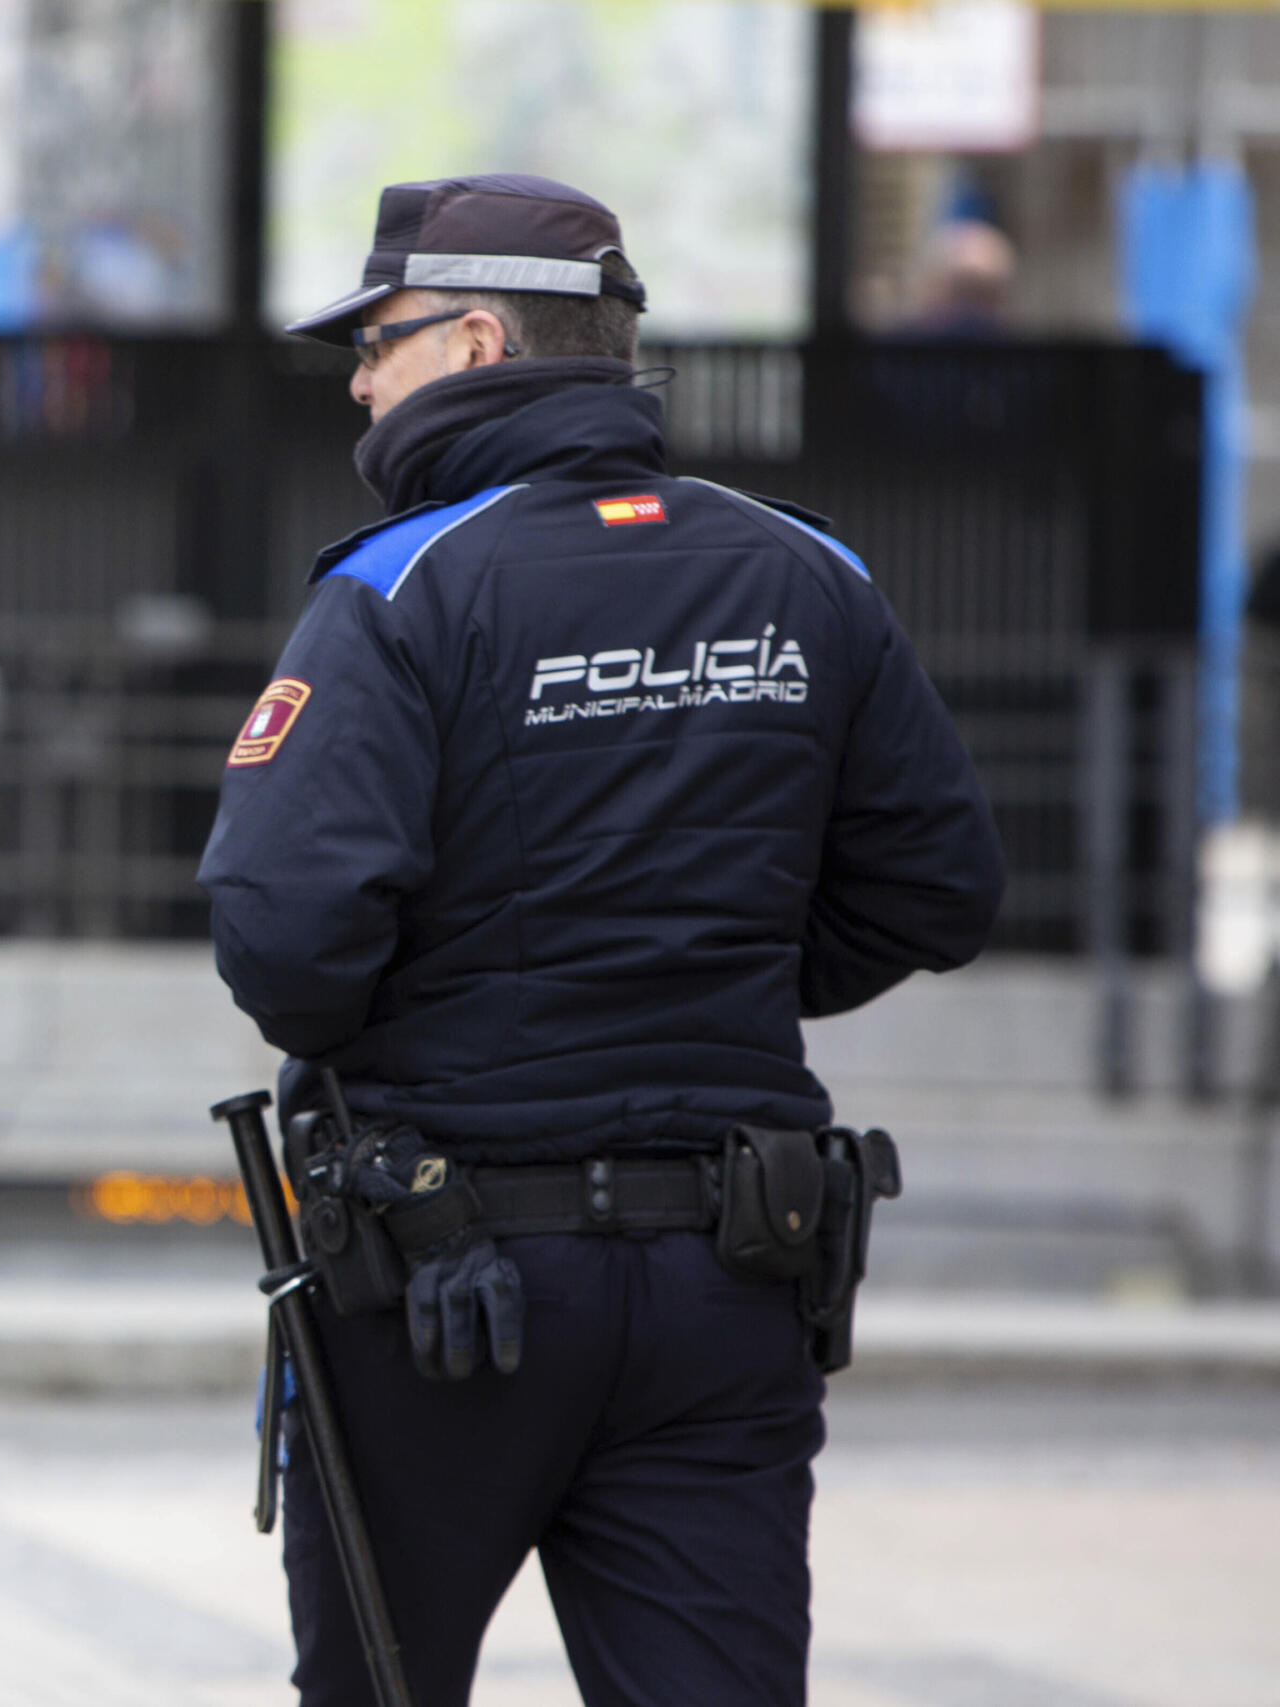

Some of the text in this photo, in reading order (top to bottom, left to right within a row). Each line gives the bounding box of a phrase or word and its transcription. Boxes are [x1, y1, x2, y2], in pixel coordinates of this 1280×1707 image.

[530, 622, 809, 700] POLICÍA
[524, 681, 809, 726] MUNICIPAL MADRID
